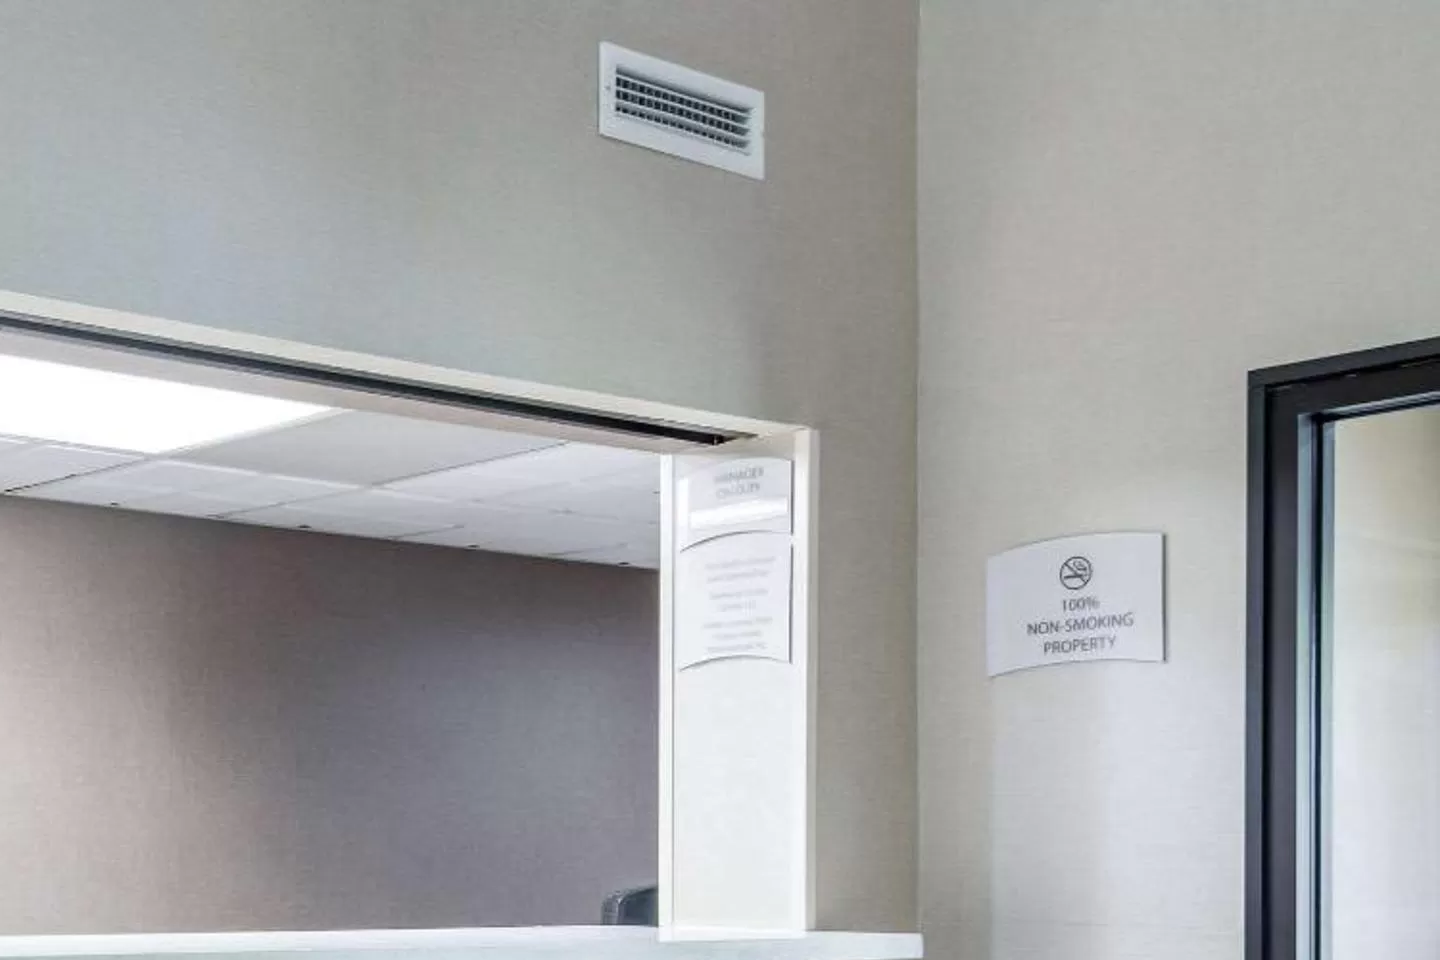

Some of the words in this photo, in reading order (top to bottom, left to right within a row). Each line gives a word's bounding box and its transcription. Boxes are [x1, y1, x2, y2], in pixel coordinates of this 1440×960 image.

[1062, 596, 1101, 612] 100%
[1027, 611, 1134, 636] NON-SMOKING
[1043, 635, 1117, 655] PROPERTY
